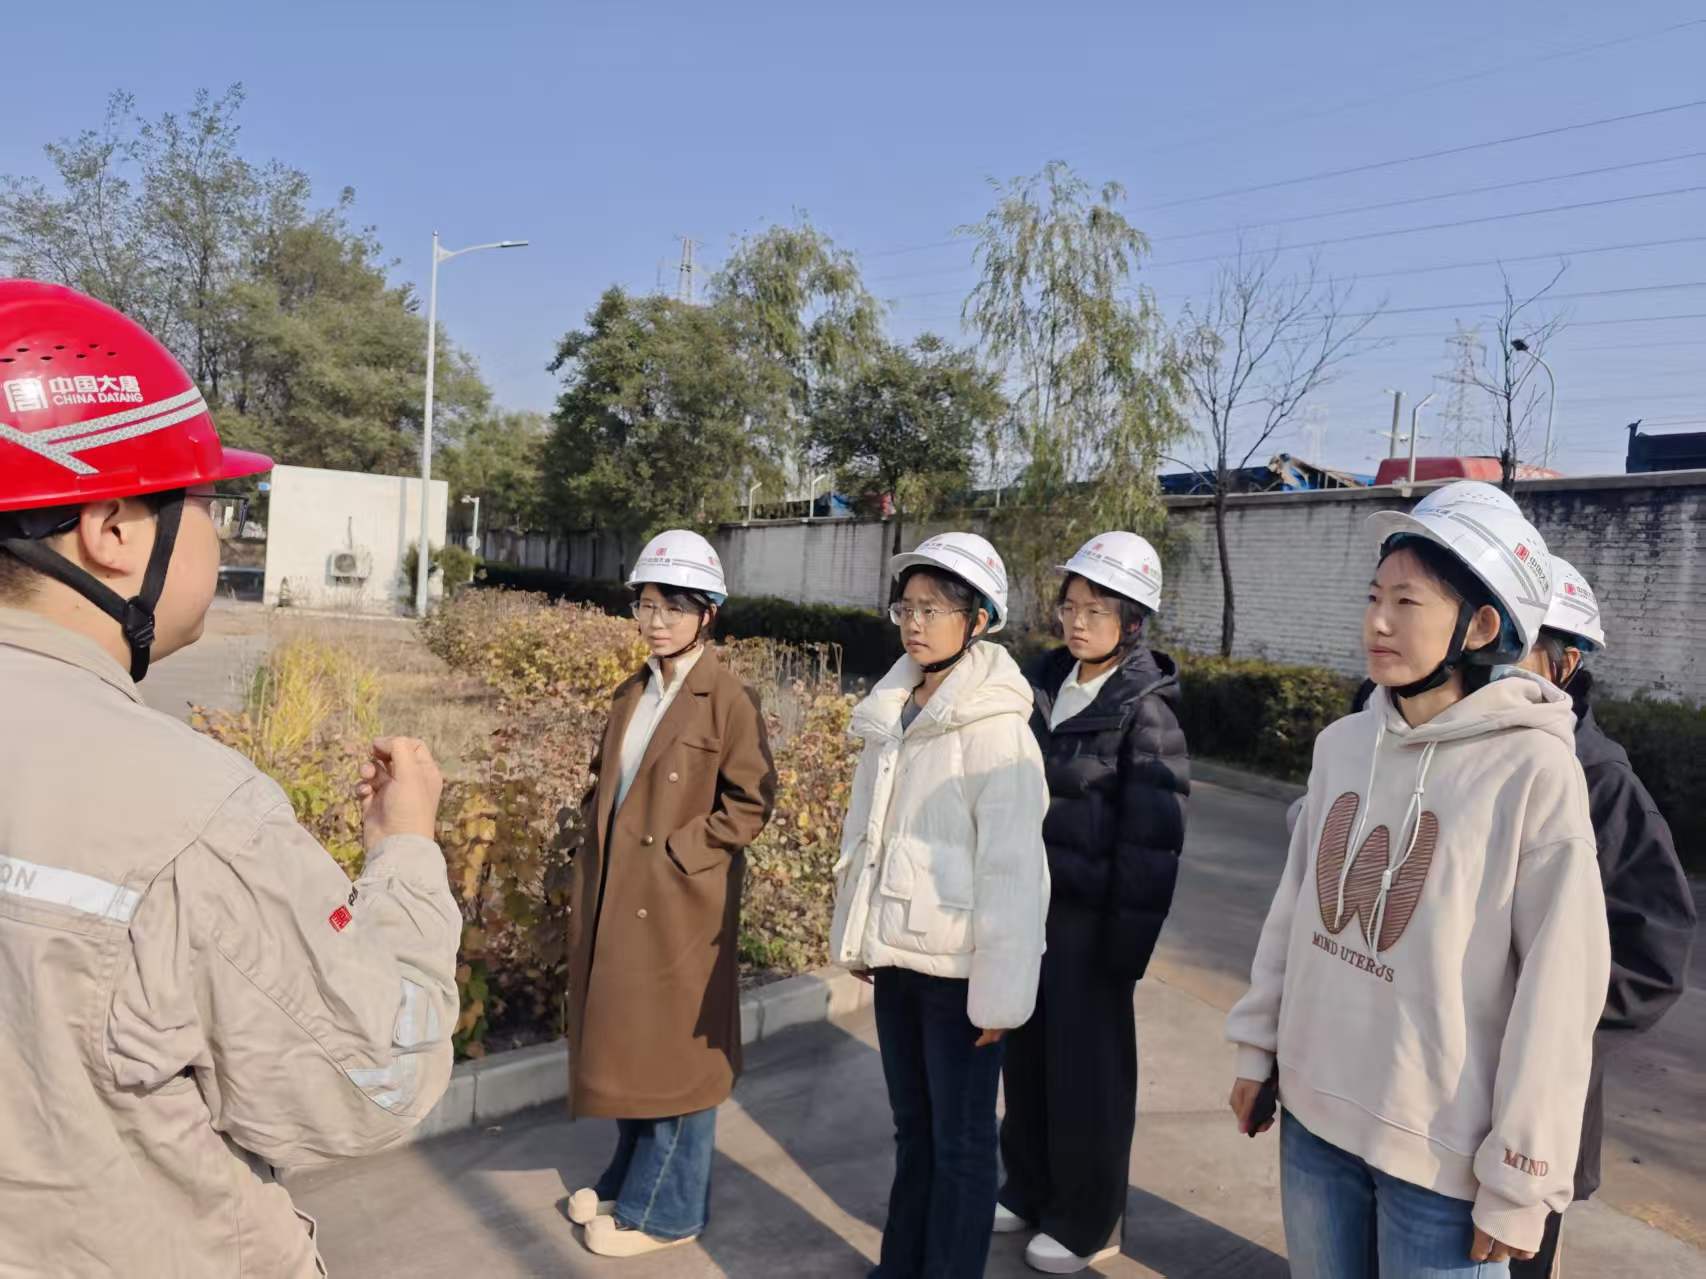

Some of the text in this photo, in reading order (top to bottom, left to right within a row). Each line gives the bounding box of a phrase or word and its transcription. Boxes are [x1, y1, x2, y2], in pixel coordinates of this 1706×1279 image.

[48, 375, 140, 393] 中国大唐
[53, 392, 144, 406] CHINA DATANG
[1312, 931, 1338, 955] MIND
[1503, 1147, 1549, 1177] MIND
